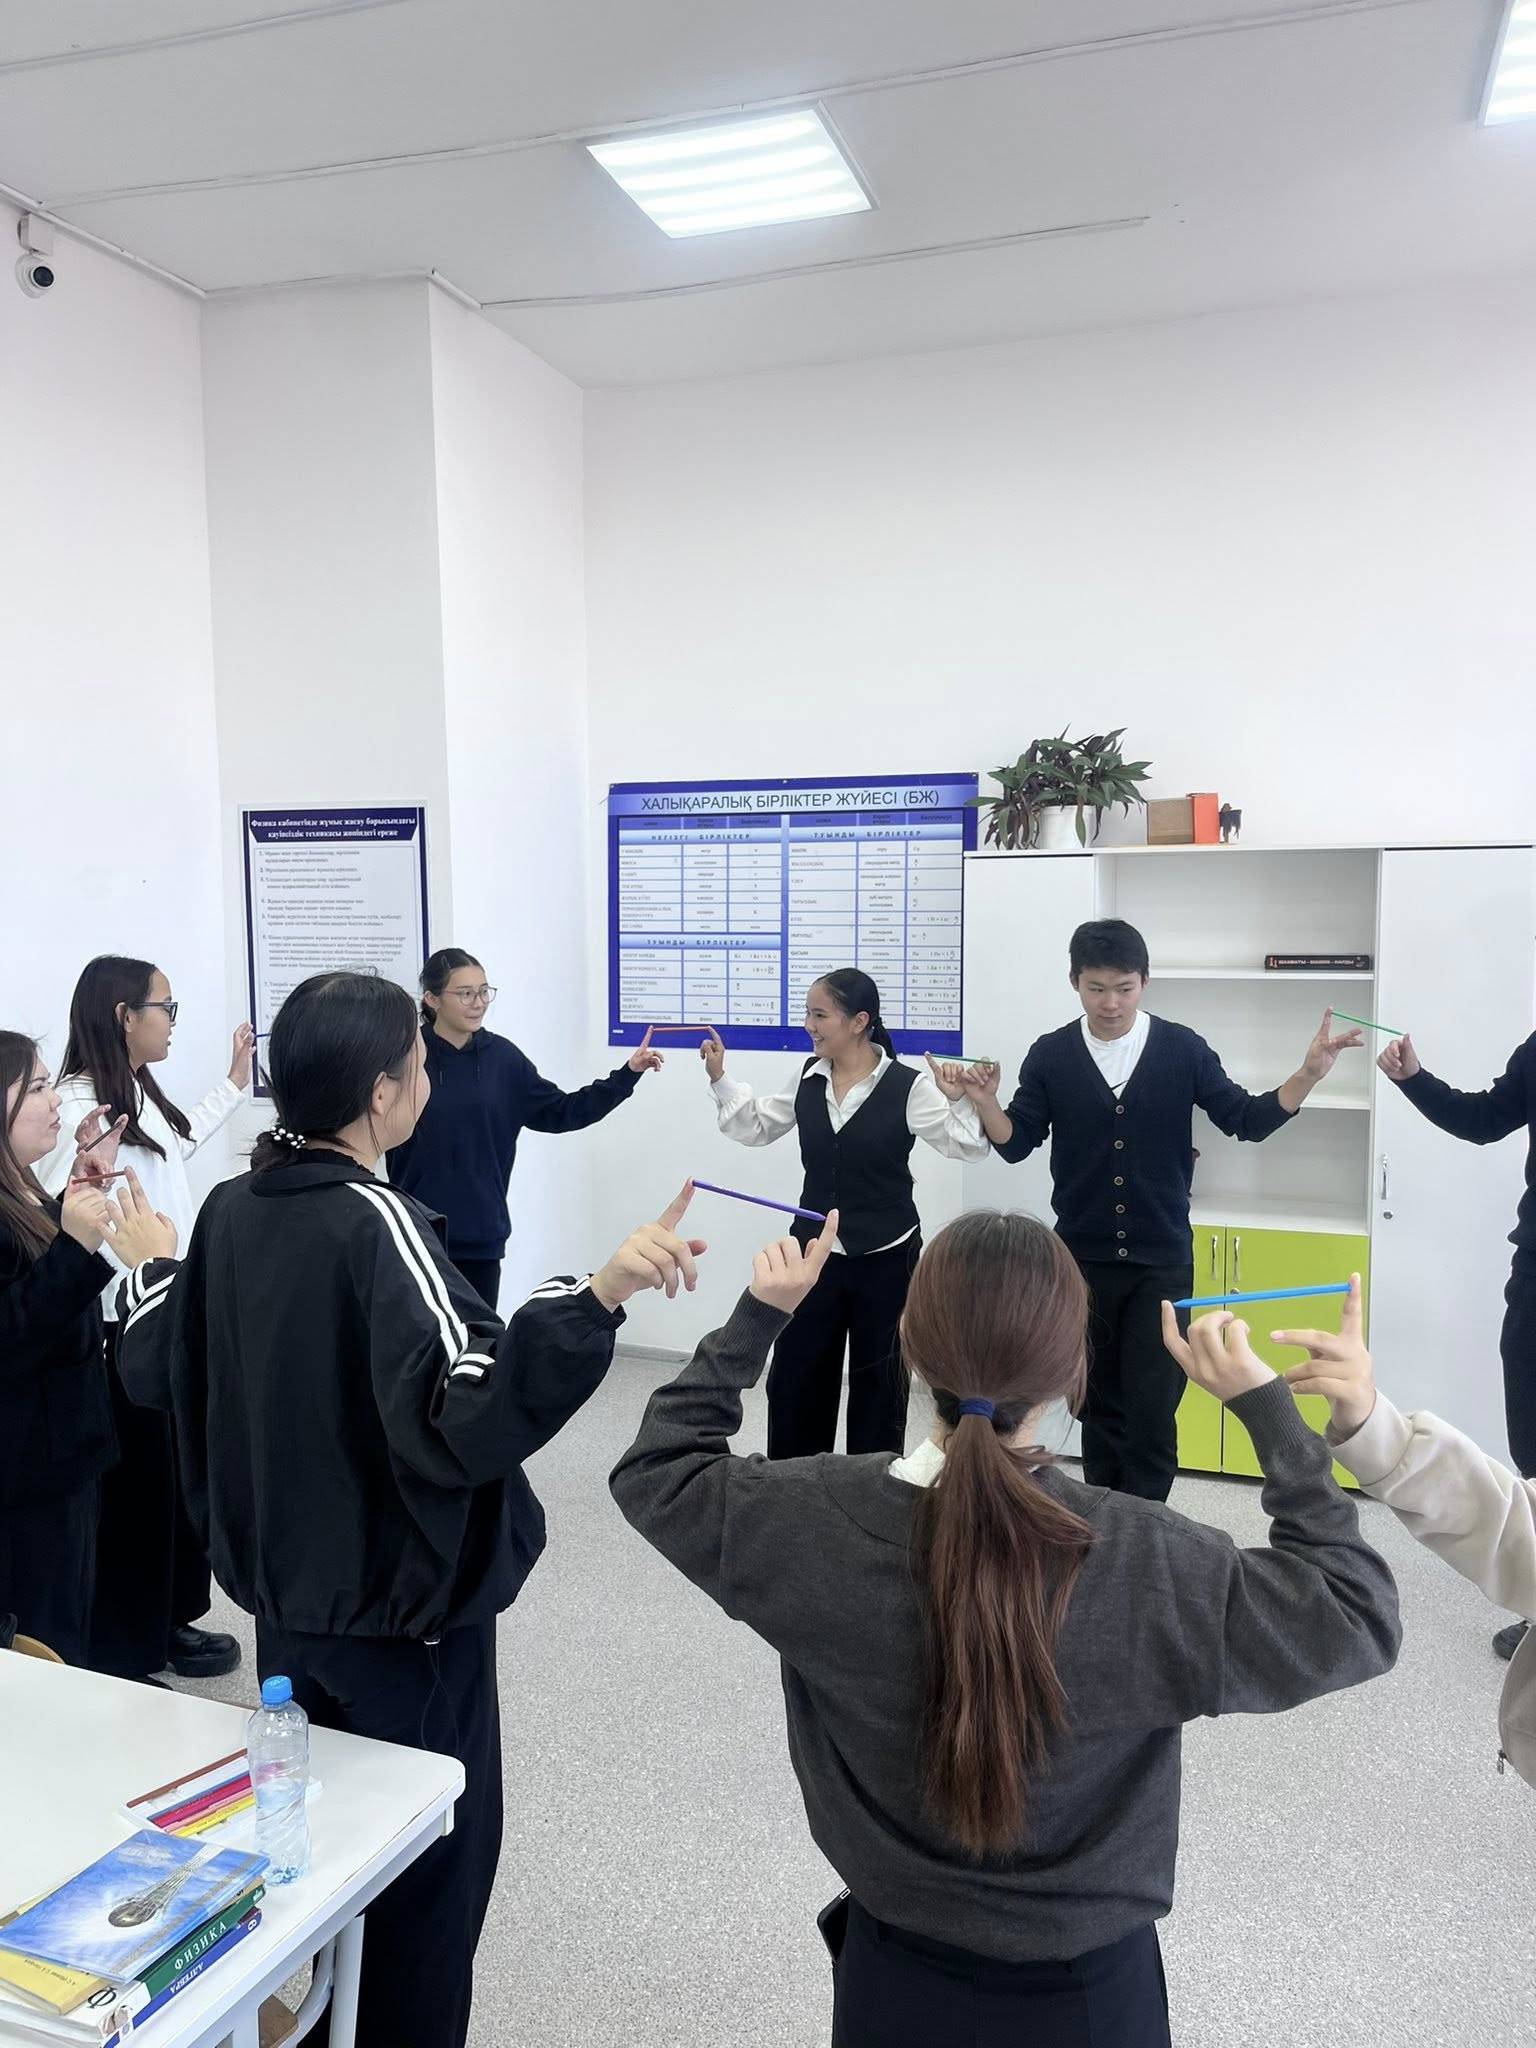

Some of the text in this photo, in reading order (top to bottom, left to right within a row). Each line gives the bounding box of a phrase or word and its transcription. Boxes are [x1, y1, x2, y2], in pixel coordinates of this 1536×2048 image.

[641, 790, 939, 811] ХАЛЫҚАРАЛЫҚ БІРЛІКТЕР ЖҮЙЕСІ (БЖ)
[699, 833, 750, 841] БІРЛІКТЕР
[866, 830, 921, 838] БІРЛІКТЕР
[174, 1921, 227, 1970] ФИЗИКА
[169, 1962, 204, 1994] АЛГЕБРА
